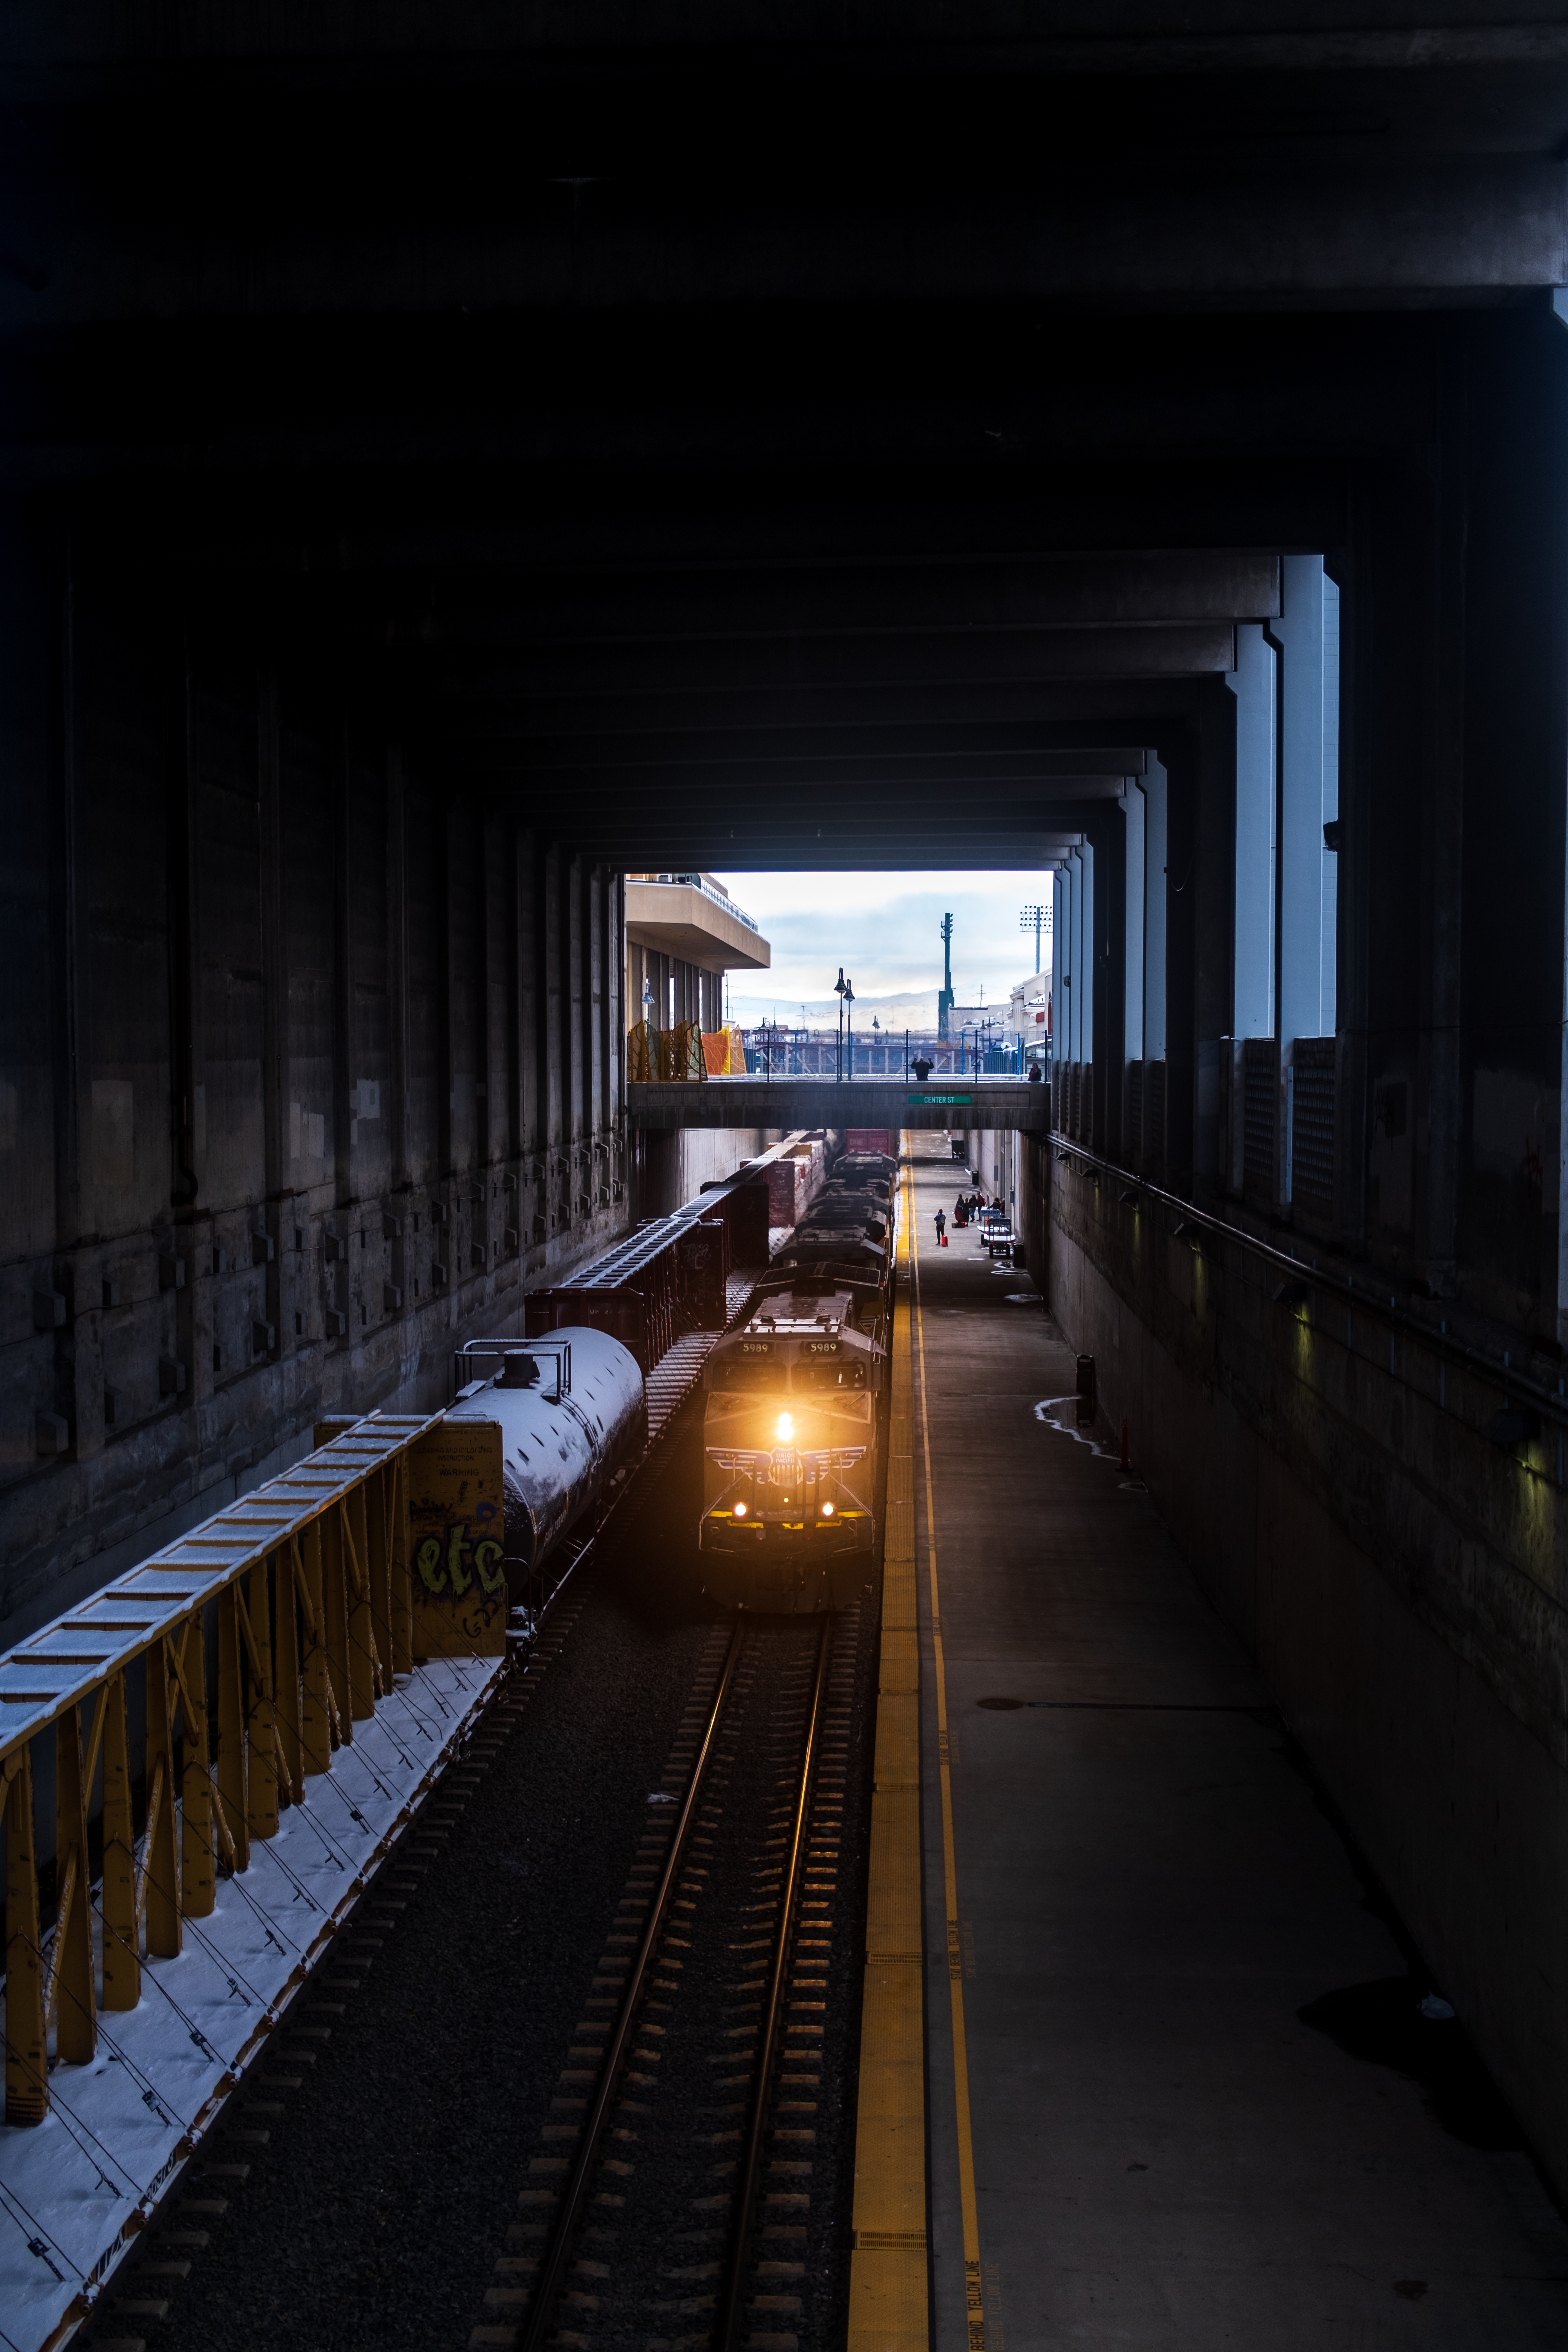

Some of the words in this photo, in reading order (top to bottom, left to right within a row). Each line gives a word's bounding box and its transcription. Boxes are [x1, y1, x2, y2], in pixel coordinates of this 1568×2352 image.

[743, 1343, 768, 1352] 5989
[810, 1343, 836, 1352] 5989
[947, 1920, 957, 1928] LINE
[948, 1930, 959, 1946] YELLOW
[949, 1951, 960, 1966] BEHIND
[950, 1968, 961, 1980] STAY
[965, 2260, 980, 2277] LINE
[985, 2263, 1000, 2280] LINE
[966, 2281, 982, 2311] YELLOW
[986, 2285, 1001, 2315] YELLOW
[969, 2321, 985, 2351] BEHIND
[989, 2320, 1004, 2351] BEHIND
